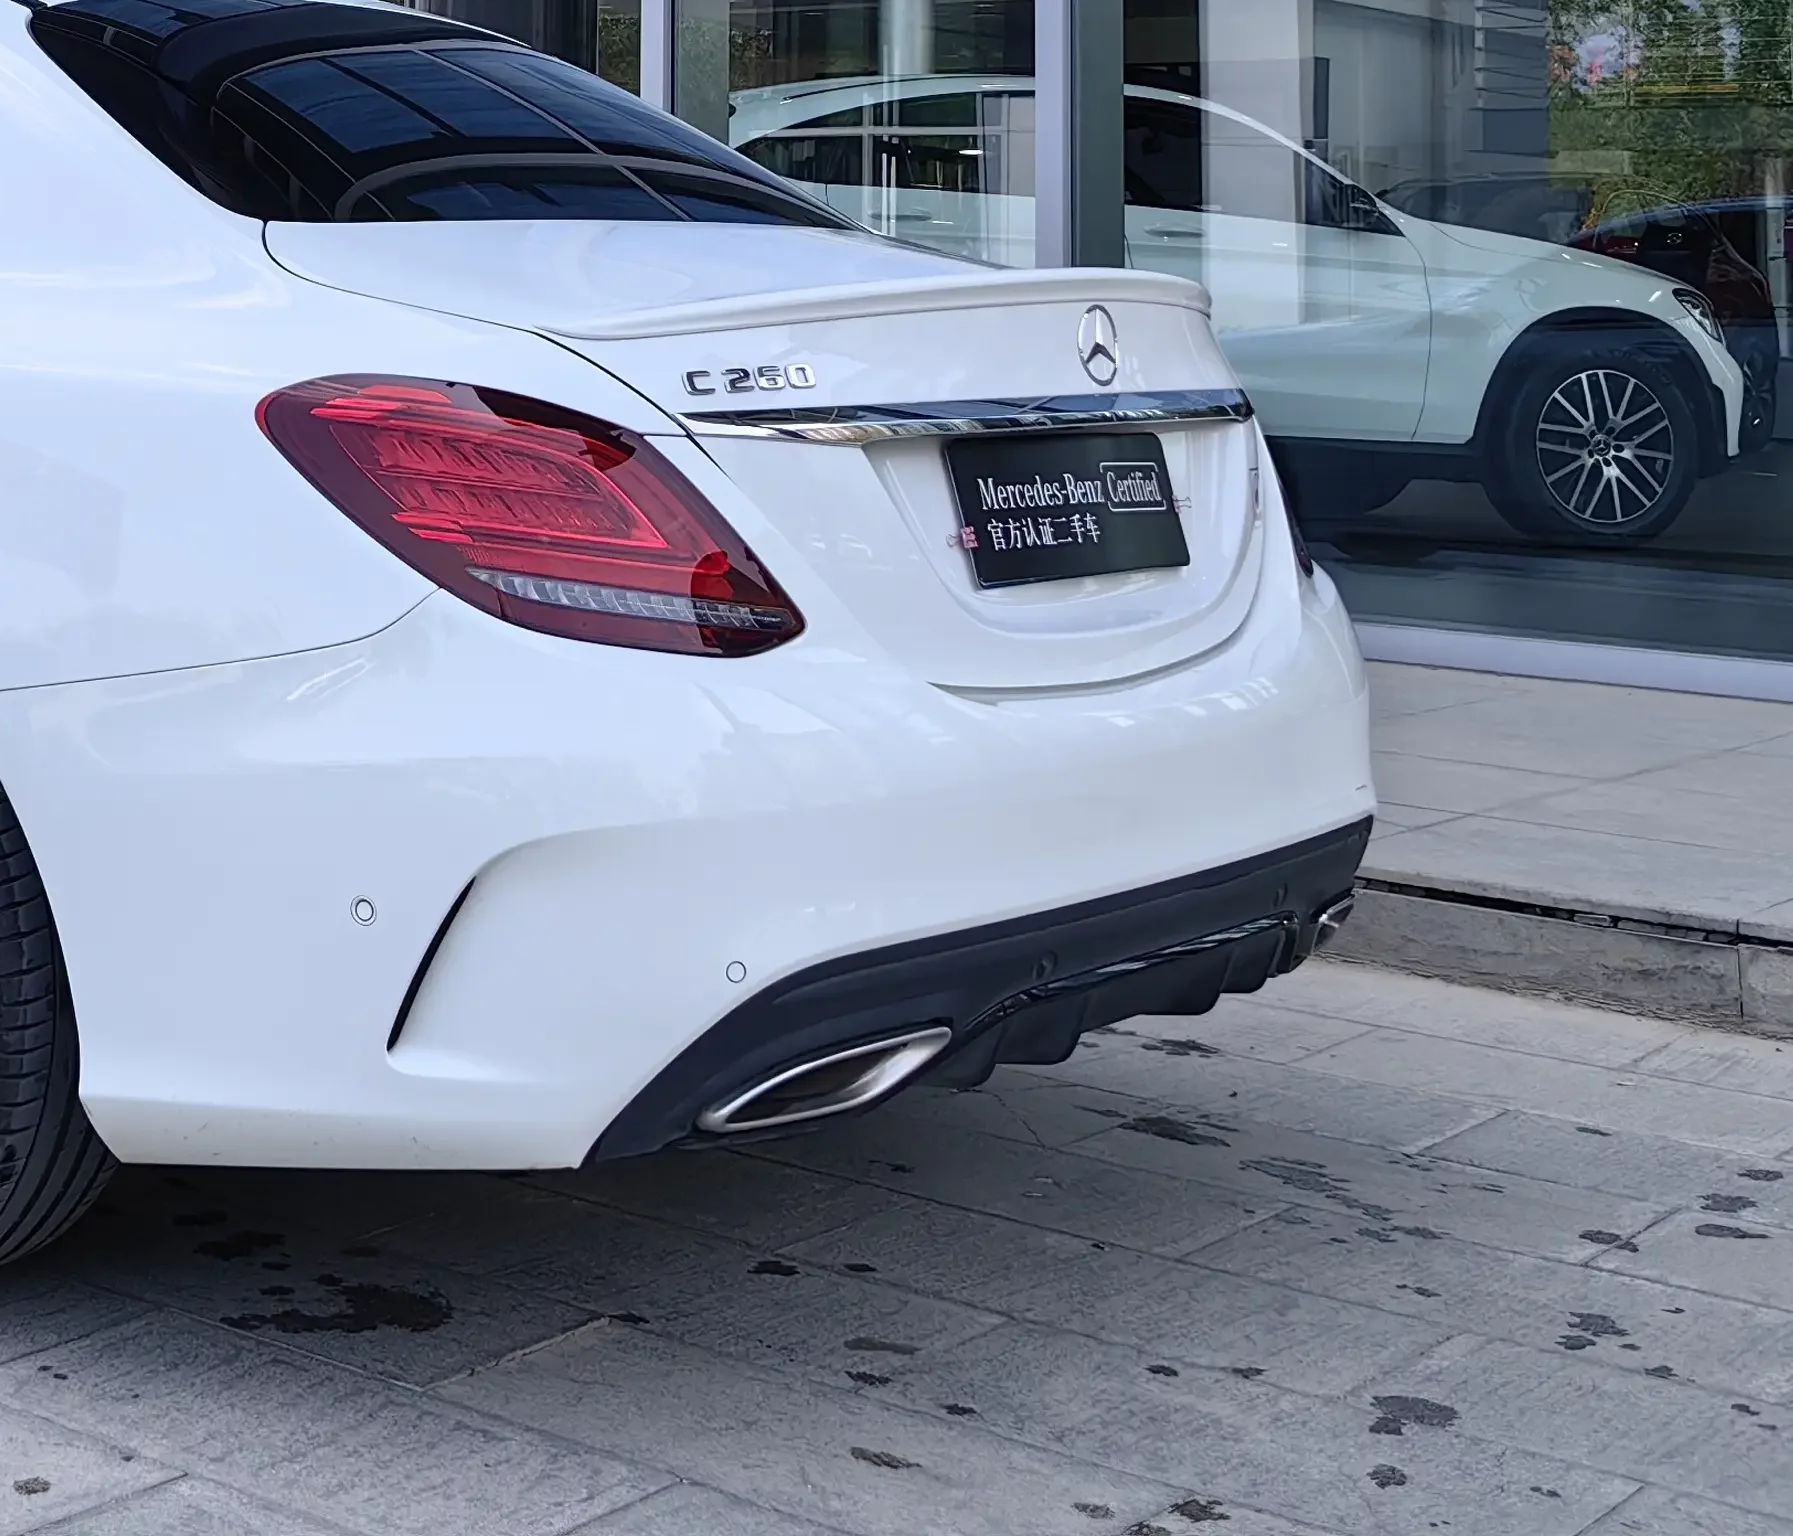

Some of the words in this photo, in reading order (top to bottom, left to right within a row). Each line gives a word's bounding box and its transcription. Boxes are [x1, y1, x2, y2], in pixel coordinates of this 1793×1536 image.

[682, 370, 716, 396] C
[721, 364, 816, 394] 260
[976, 472, 1106, 511] Mercedes-Benz
[1106, 470, 1162, 503] Certified
[987, 512, 1101, 551] 官方认证二手车
